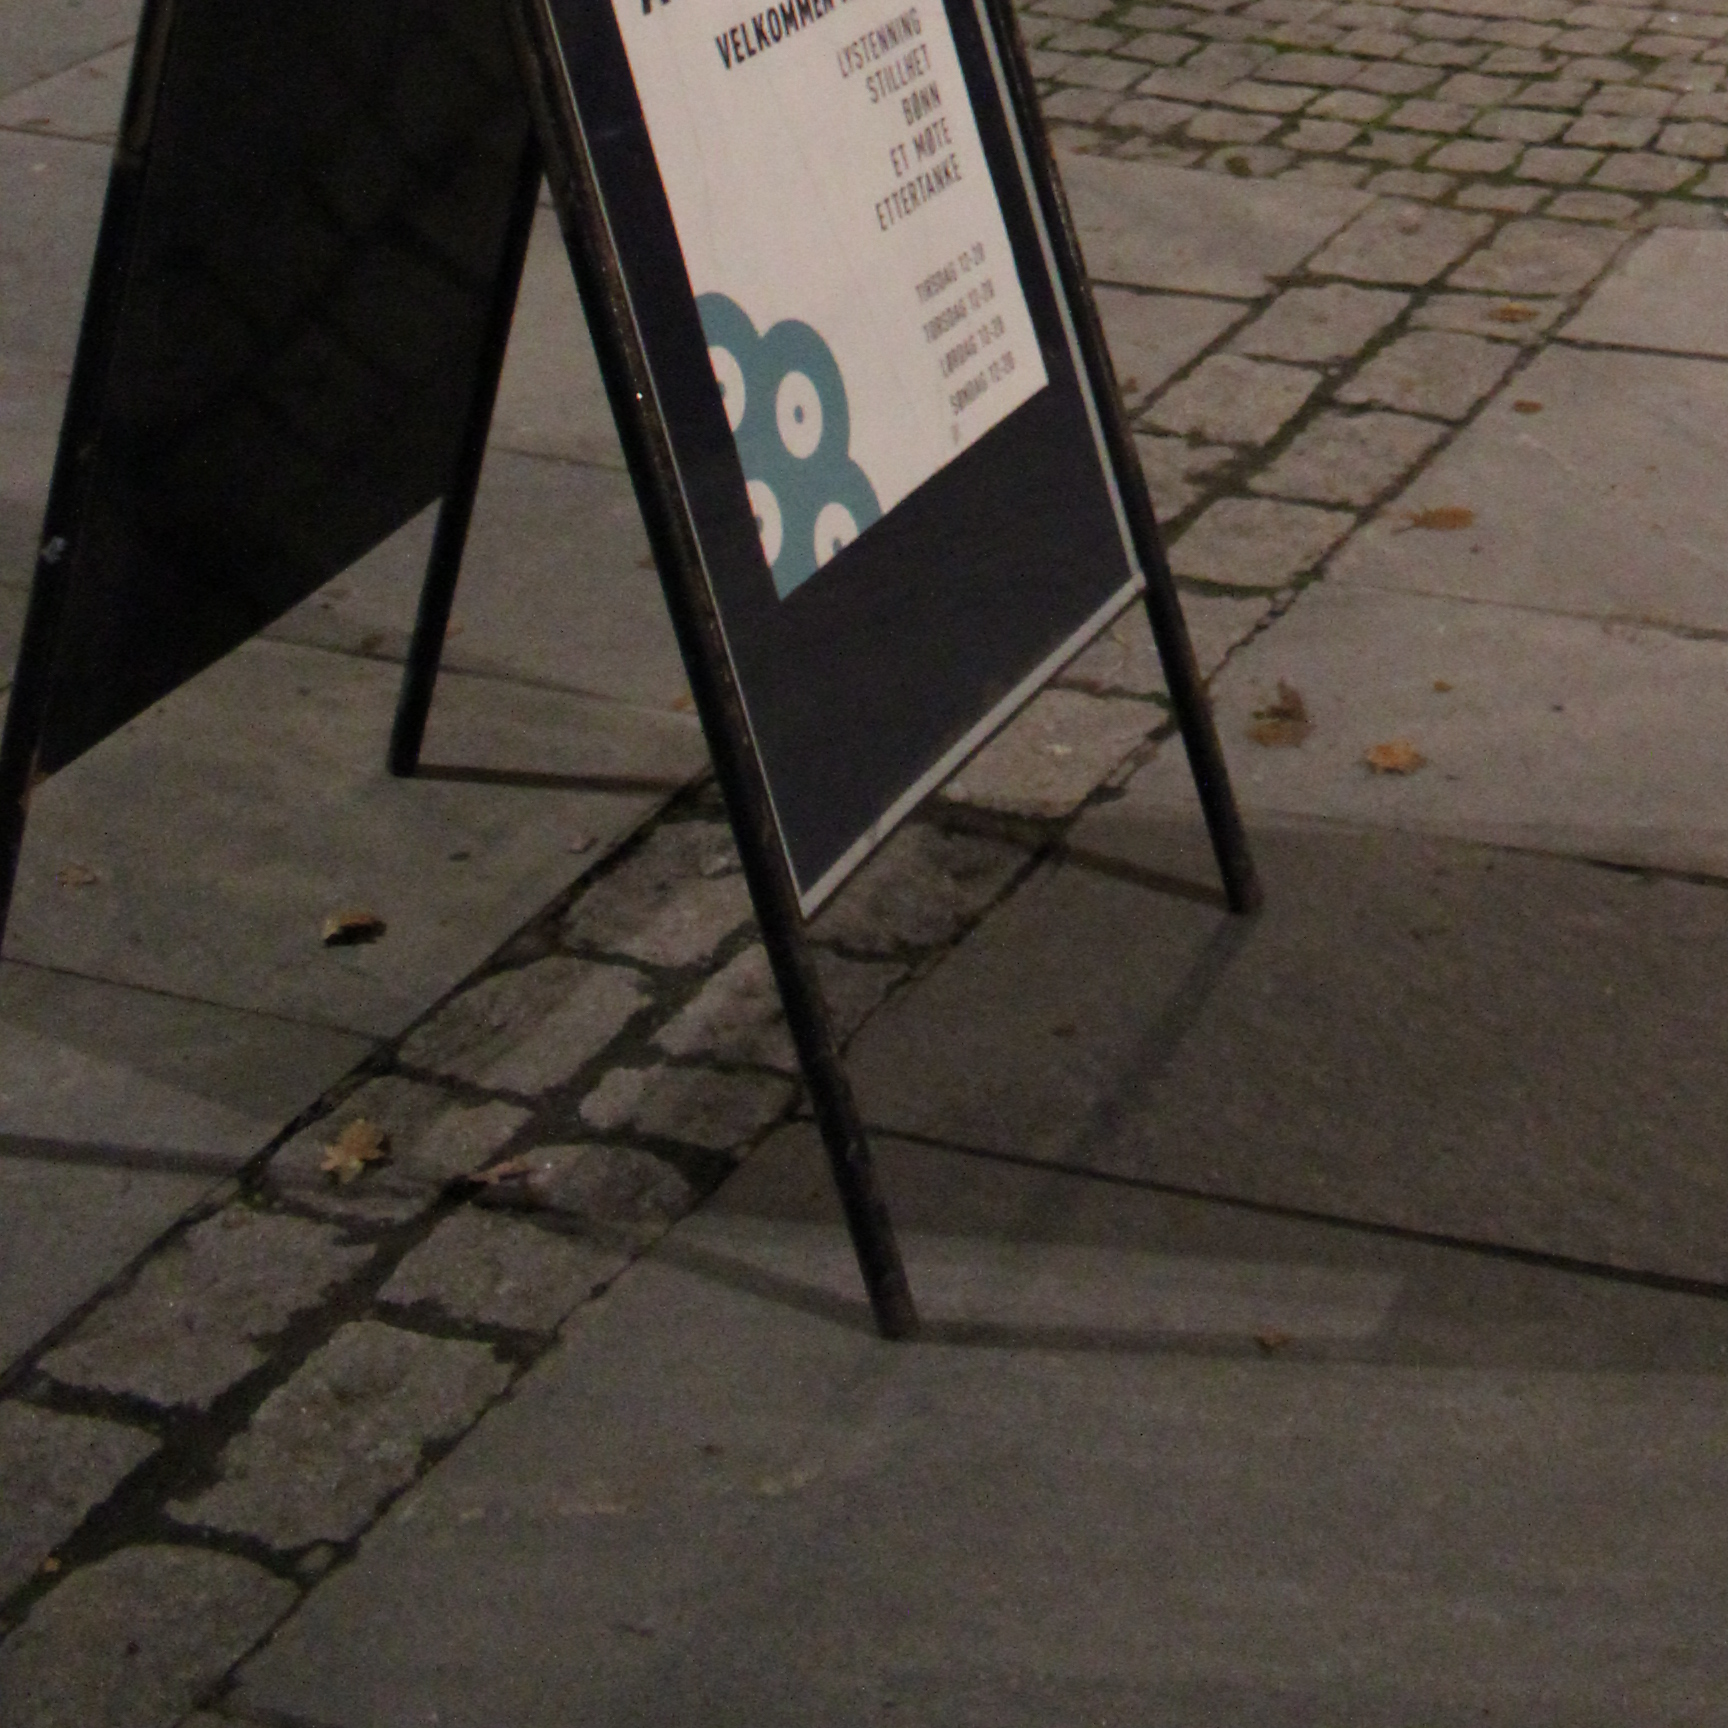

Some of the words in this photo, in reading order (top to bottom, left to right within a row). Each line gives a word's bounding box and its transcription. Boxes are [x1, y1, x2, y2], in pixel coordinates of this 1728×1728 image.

[837, 7, 921, 78] LYSTENNING
[866, 43, 931, 103] STILLHET
[875, 152, 962, 231] ETTERTANKE
[890, 143, 909, 177] ET
